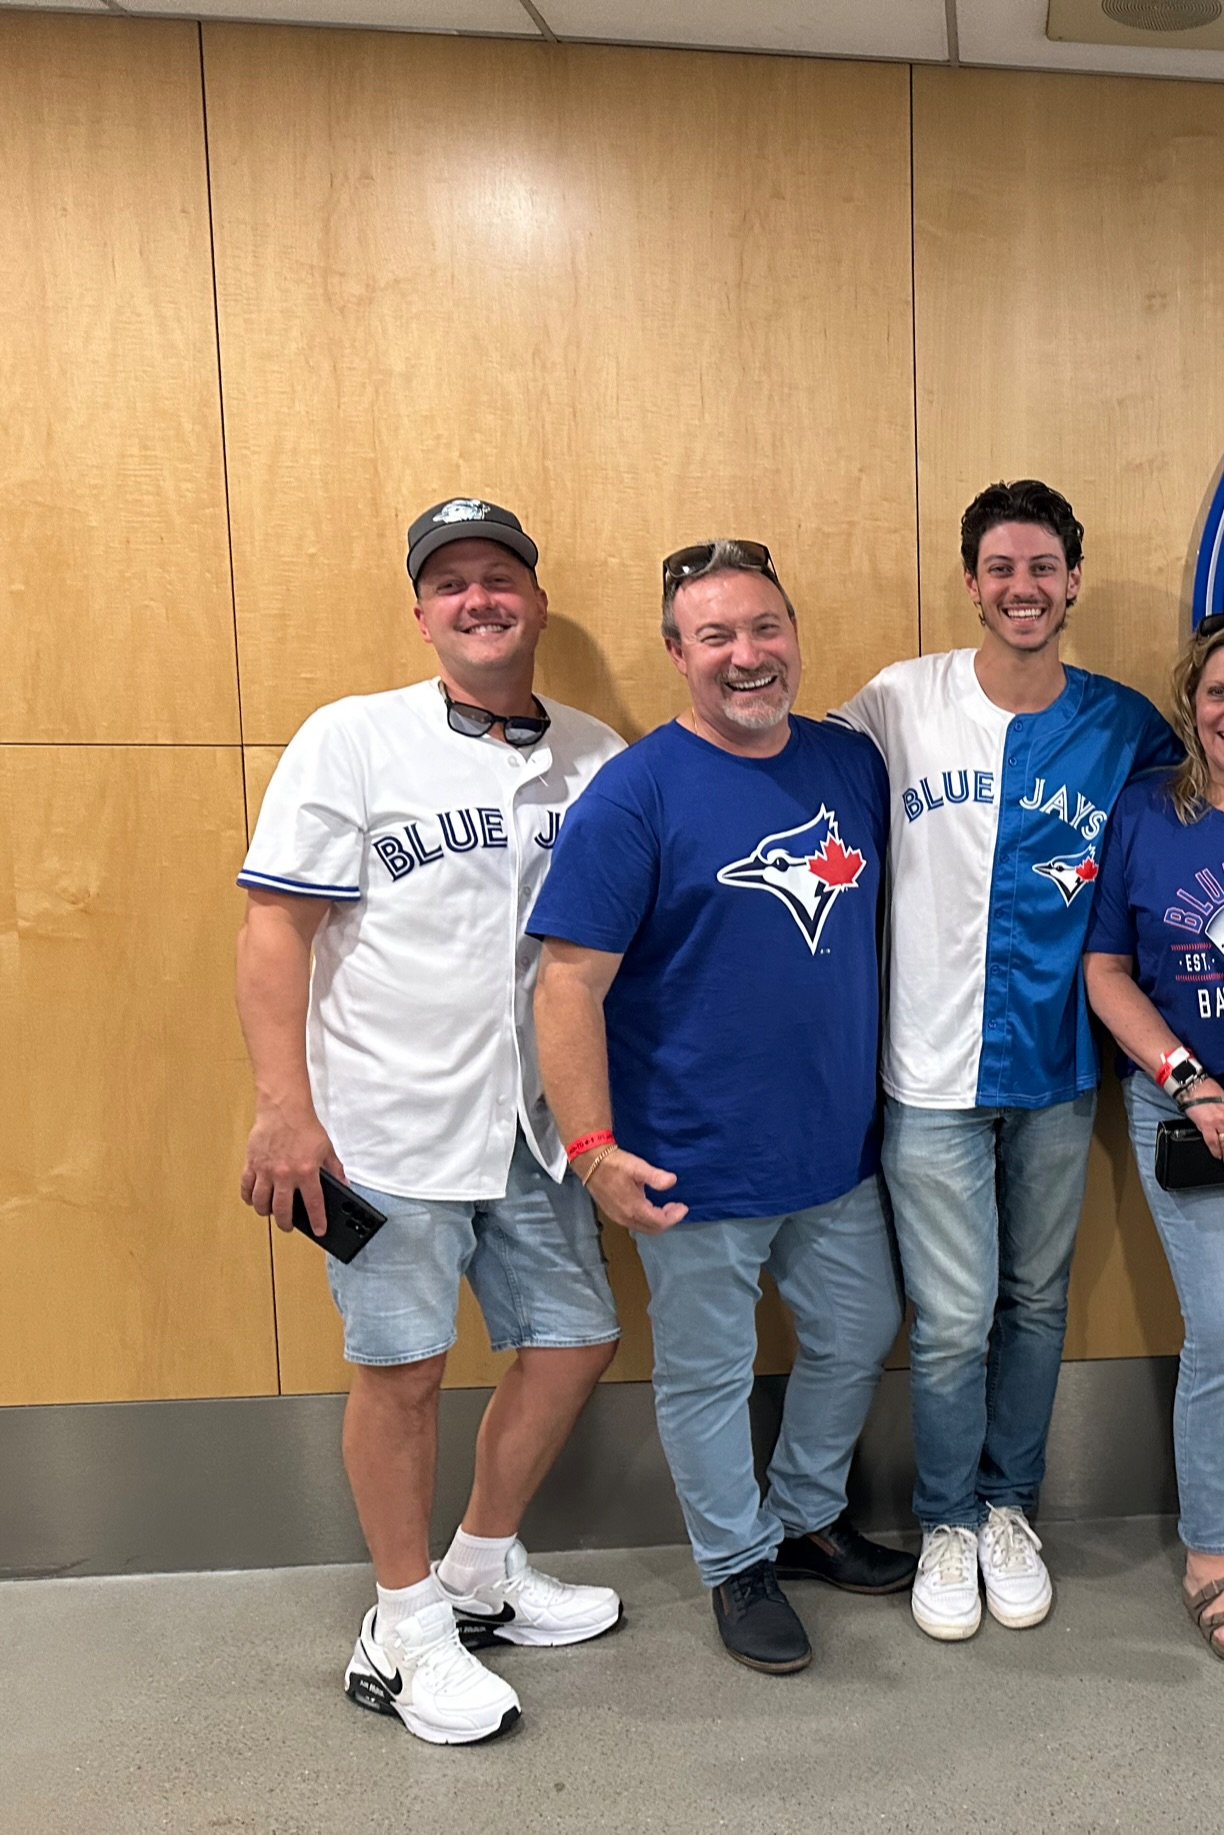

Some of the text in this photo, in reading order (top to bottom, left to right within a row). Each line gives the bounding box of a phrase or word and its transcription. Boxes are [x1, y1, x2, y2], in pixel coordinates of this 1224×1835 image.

[902, 769, 1108, 841] BLUE JAYS
[372, 807, 508, 882] BLUE
